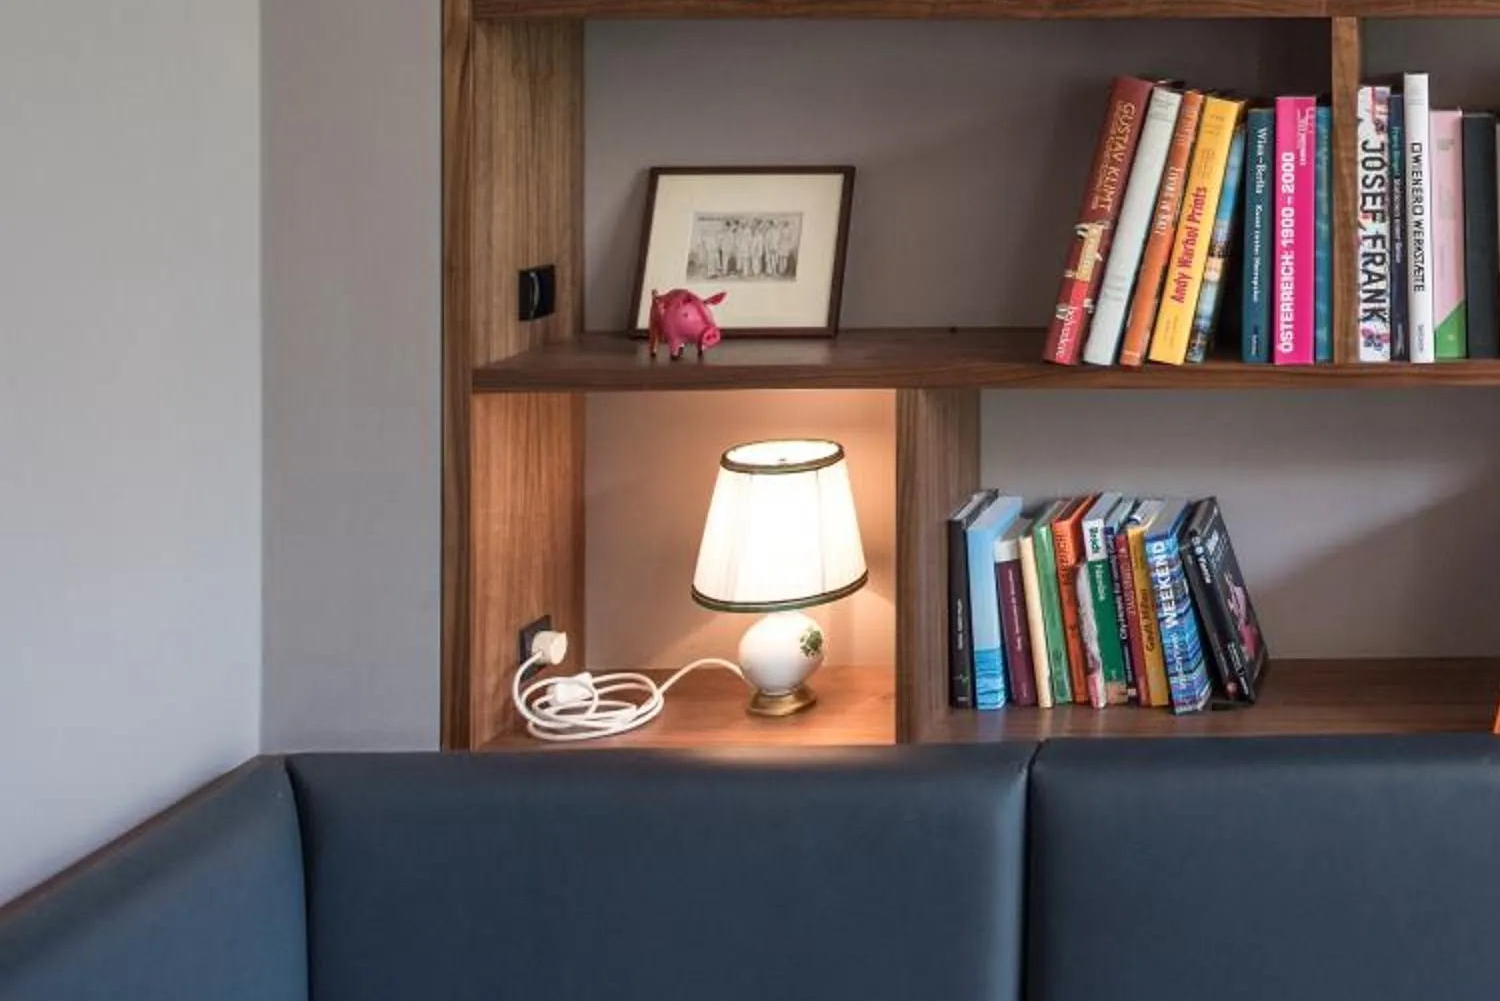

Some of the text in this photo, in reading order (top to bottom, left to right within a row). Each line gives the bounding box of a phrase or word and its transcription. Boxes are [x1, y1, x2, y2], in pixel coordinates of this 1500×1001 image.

[1098, 101, 1137, 212] GUSTAV KLIMT
[1281, 151, 1295, 192] 2000
[1189, 186, 1209, 223] Prints
[1177, 224, 1201, 270] Warhol
[1281, 207, 1295, 246] 1900
[1361, 139, 1388, 322] JOSEF FRANK
[1169, 271, 1193, 304] Andy
[1152, 540, 1179, 627] WEEKEND
